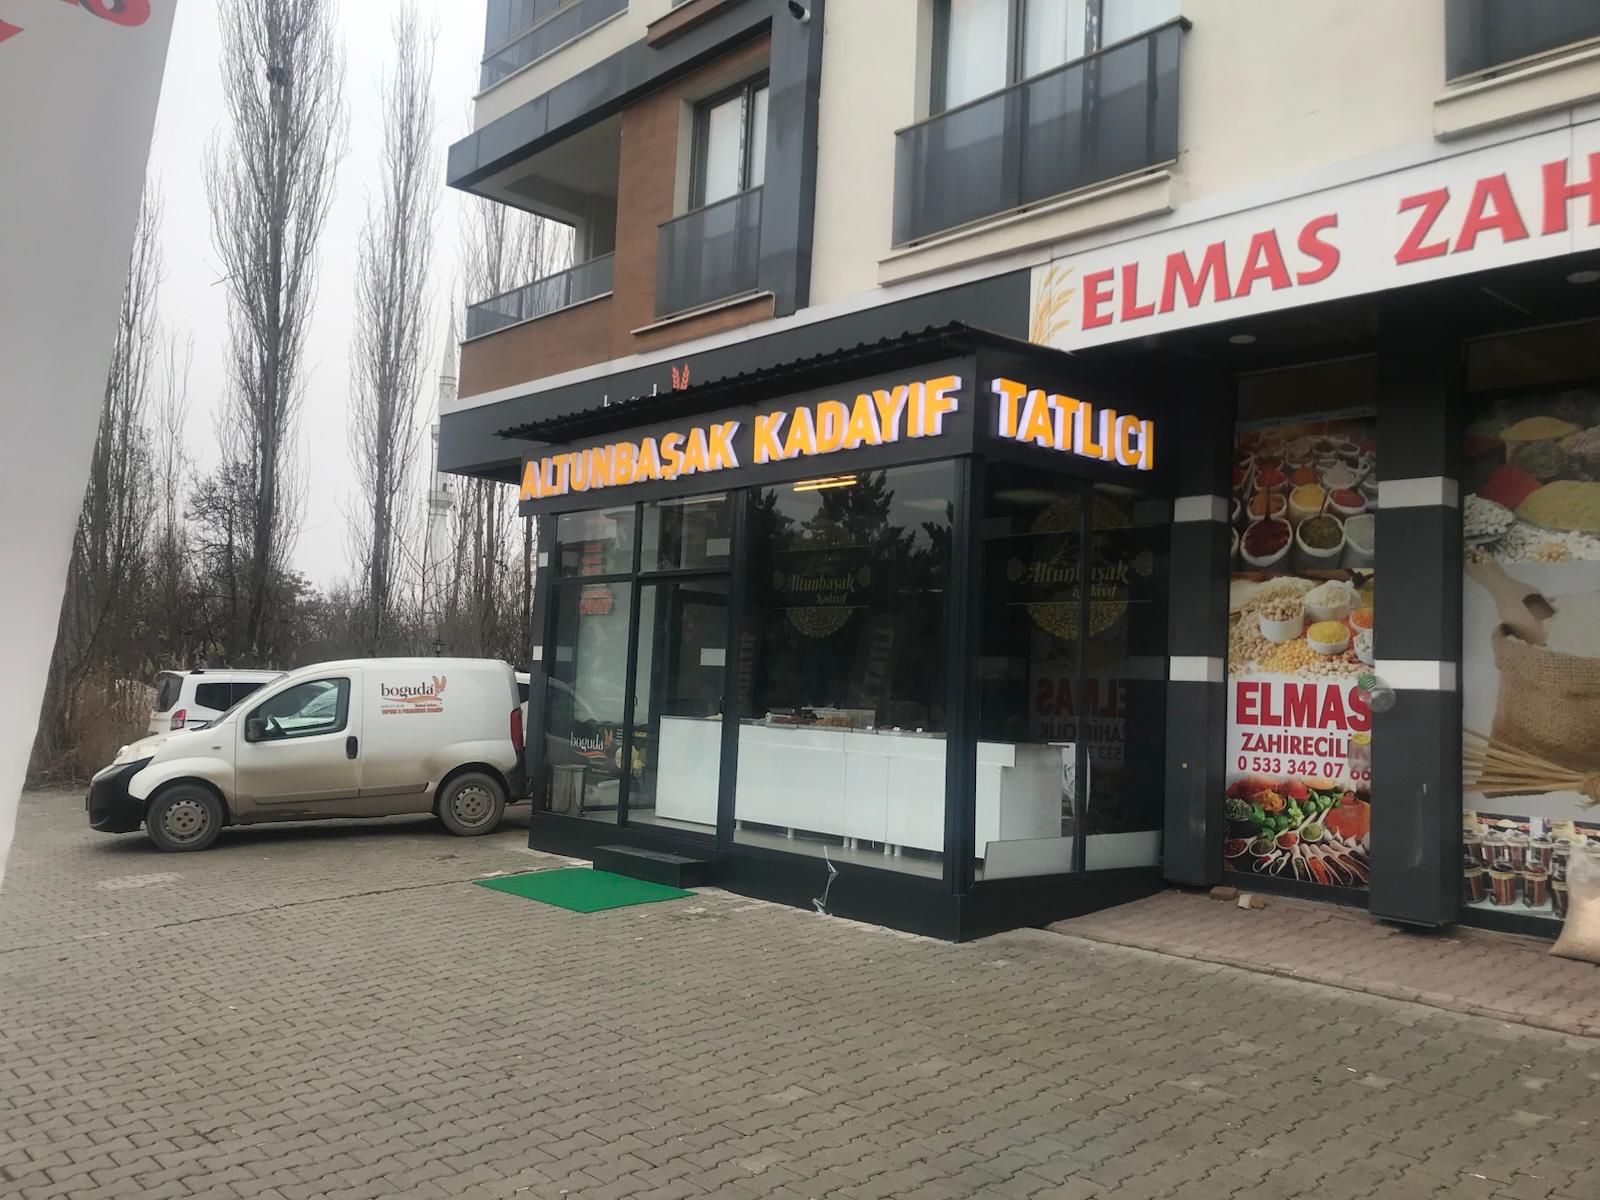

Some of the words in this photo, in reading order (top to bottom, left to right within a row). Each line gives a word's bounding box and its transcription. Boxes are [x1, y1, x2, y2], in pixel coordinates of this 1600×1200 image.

[1082, 213, 1341, 331] ELMAS
[1394, 151, 1600, 266] ZAH
[519, 421, 741, 500] ALTUNBAŞAK
[753, 375, 962, 464] KADAYIF
[991, 377, 1154, 471] TATLICI
[381, 682, 434, 699] boguda
[1236, 682, 1371, 732] ELMAS
[1238, 756, 1247, 770] 0
[1252, 757, 1281, 773] 533
[1287, 759, 1317, 776] 342
[1323, 762, 1344, 778] 07
